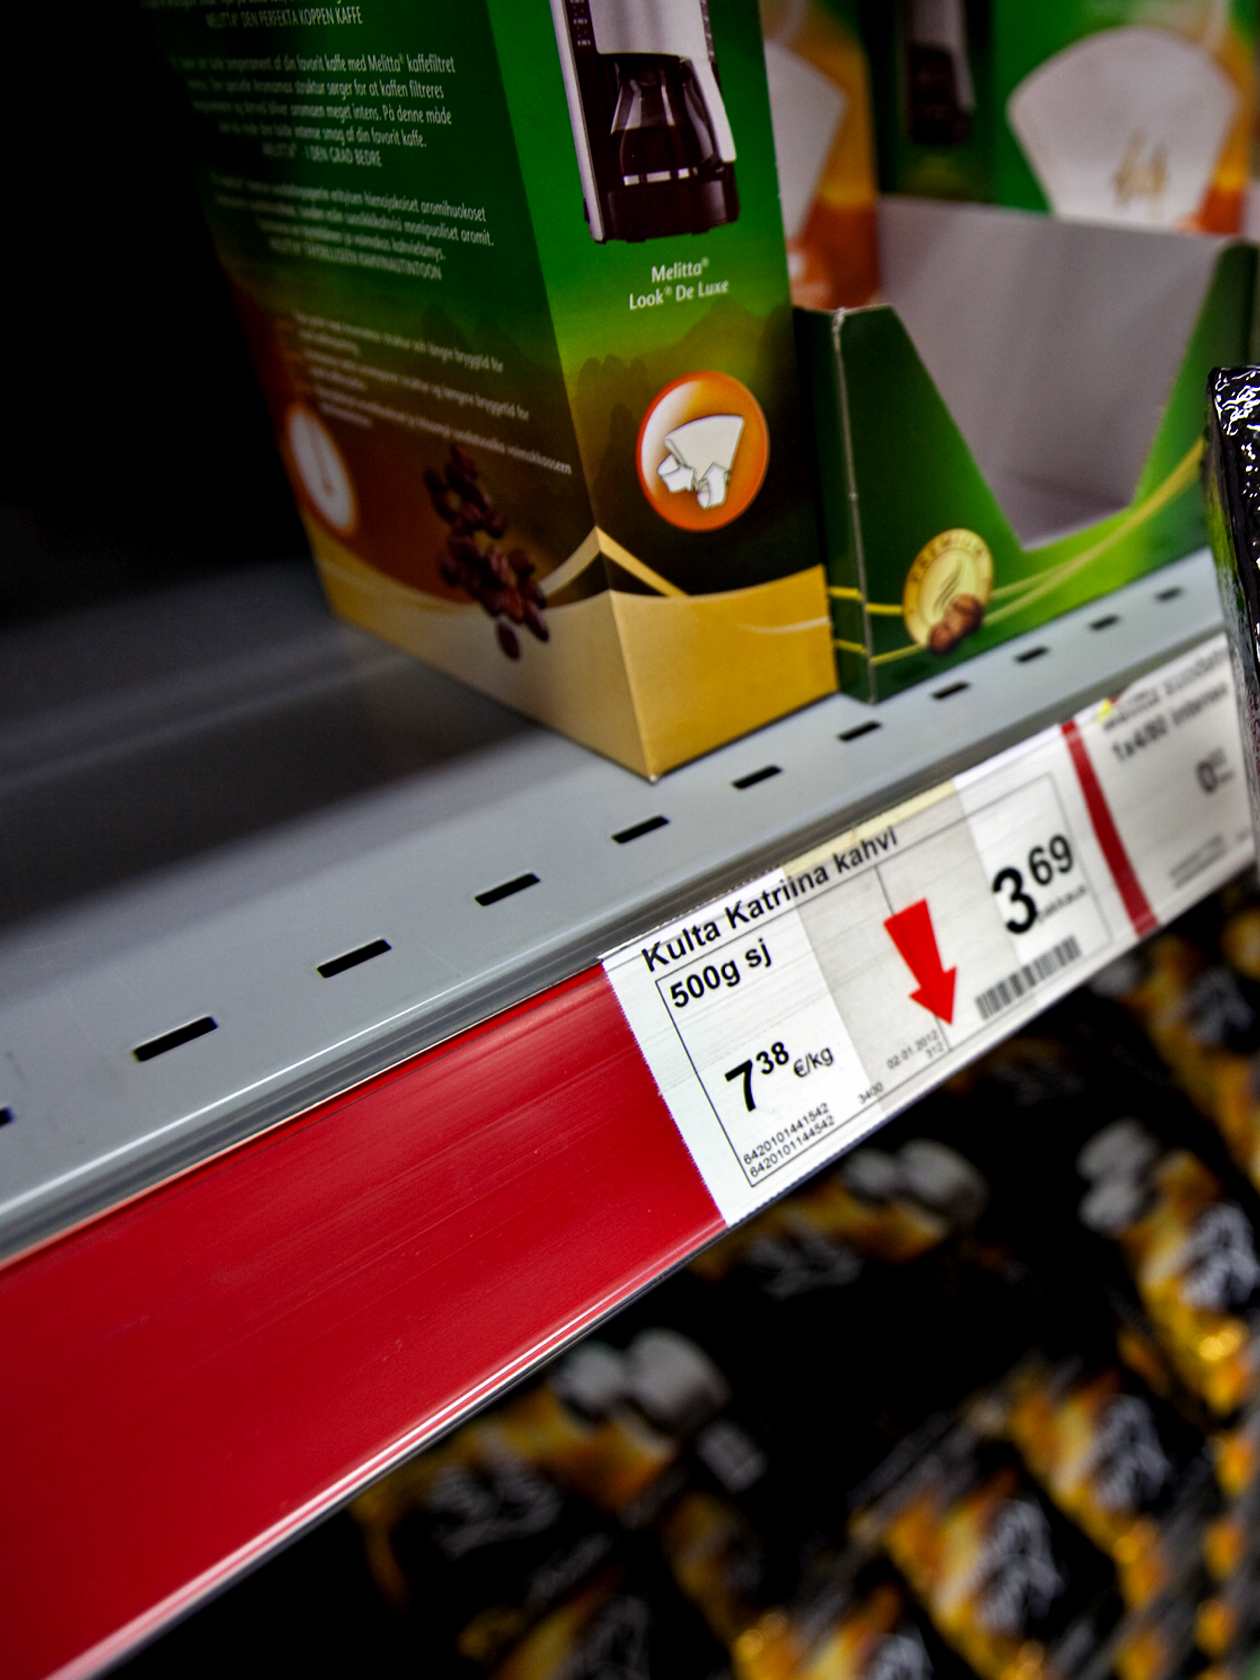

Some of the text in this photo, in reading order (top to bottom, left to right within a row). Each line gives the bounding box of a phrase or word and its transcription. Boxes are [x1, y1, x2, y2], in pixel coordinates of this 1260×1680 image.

[298, 8, 334, 25] KOPPEN
[335, 6, 363, 24] KAFFE
[324, 54, 347, 71] kaffe
[347, 54, 367, 71] med
[406, 53, 456, 73] kaffefiltret
[354, 79, 367, 96] for
[369, 80, 380, 97] at
[380, 79, 409, 98] kaffen
[409, 79, 445, 99] filtreres
[352, 103, 382, 121] intens.
[397, 105, 424, 123] denne
[426, 106, 452, 125] måde
[401, 128, 427, 147] kaffe.
[676, 284, 694, 302] De
[698, 280, 729, 297] Luxe
[641, 825, 899, 972] Kulta Katriina kahvi
[669, 937, 772, 1009] 500g sj
[793, 1047, 834, 1078] €/kg
[743, 1102, 830, 1165] 6420101441542
[749, 1115, 835, 1178] 6420101144542
